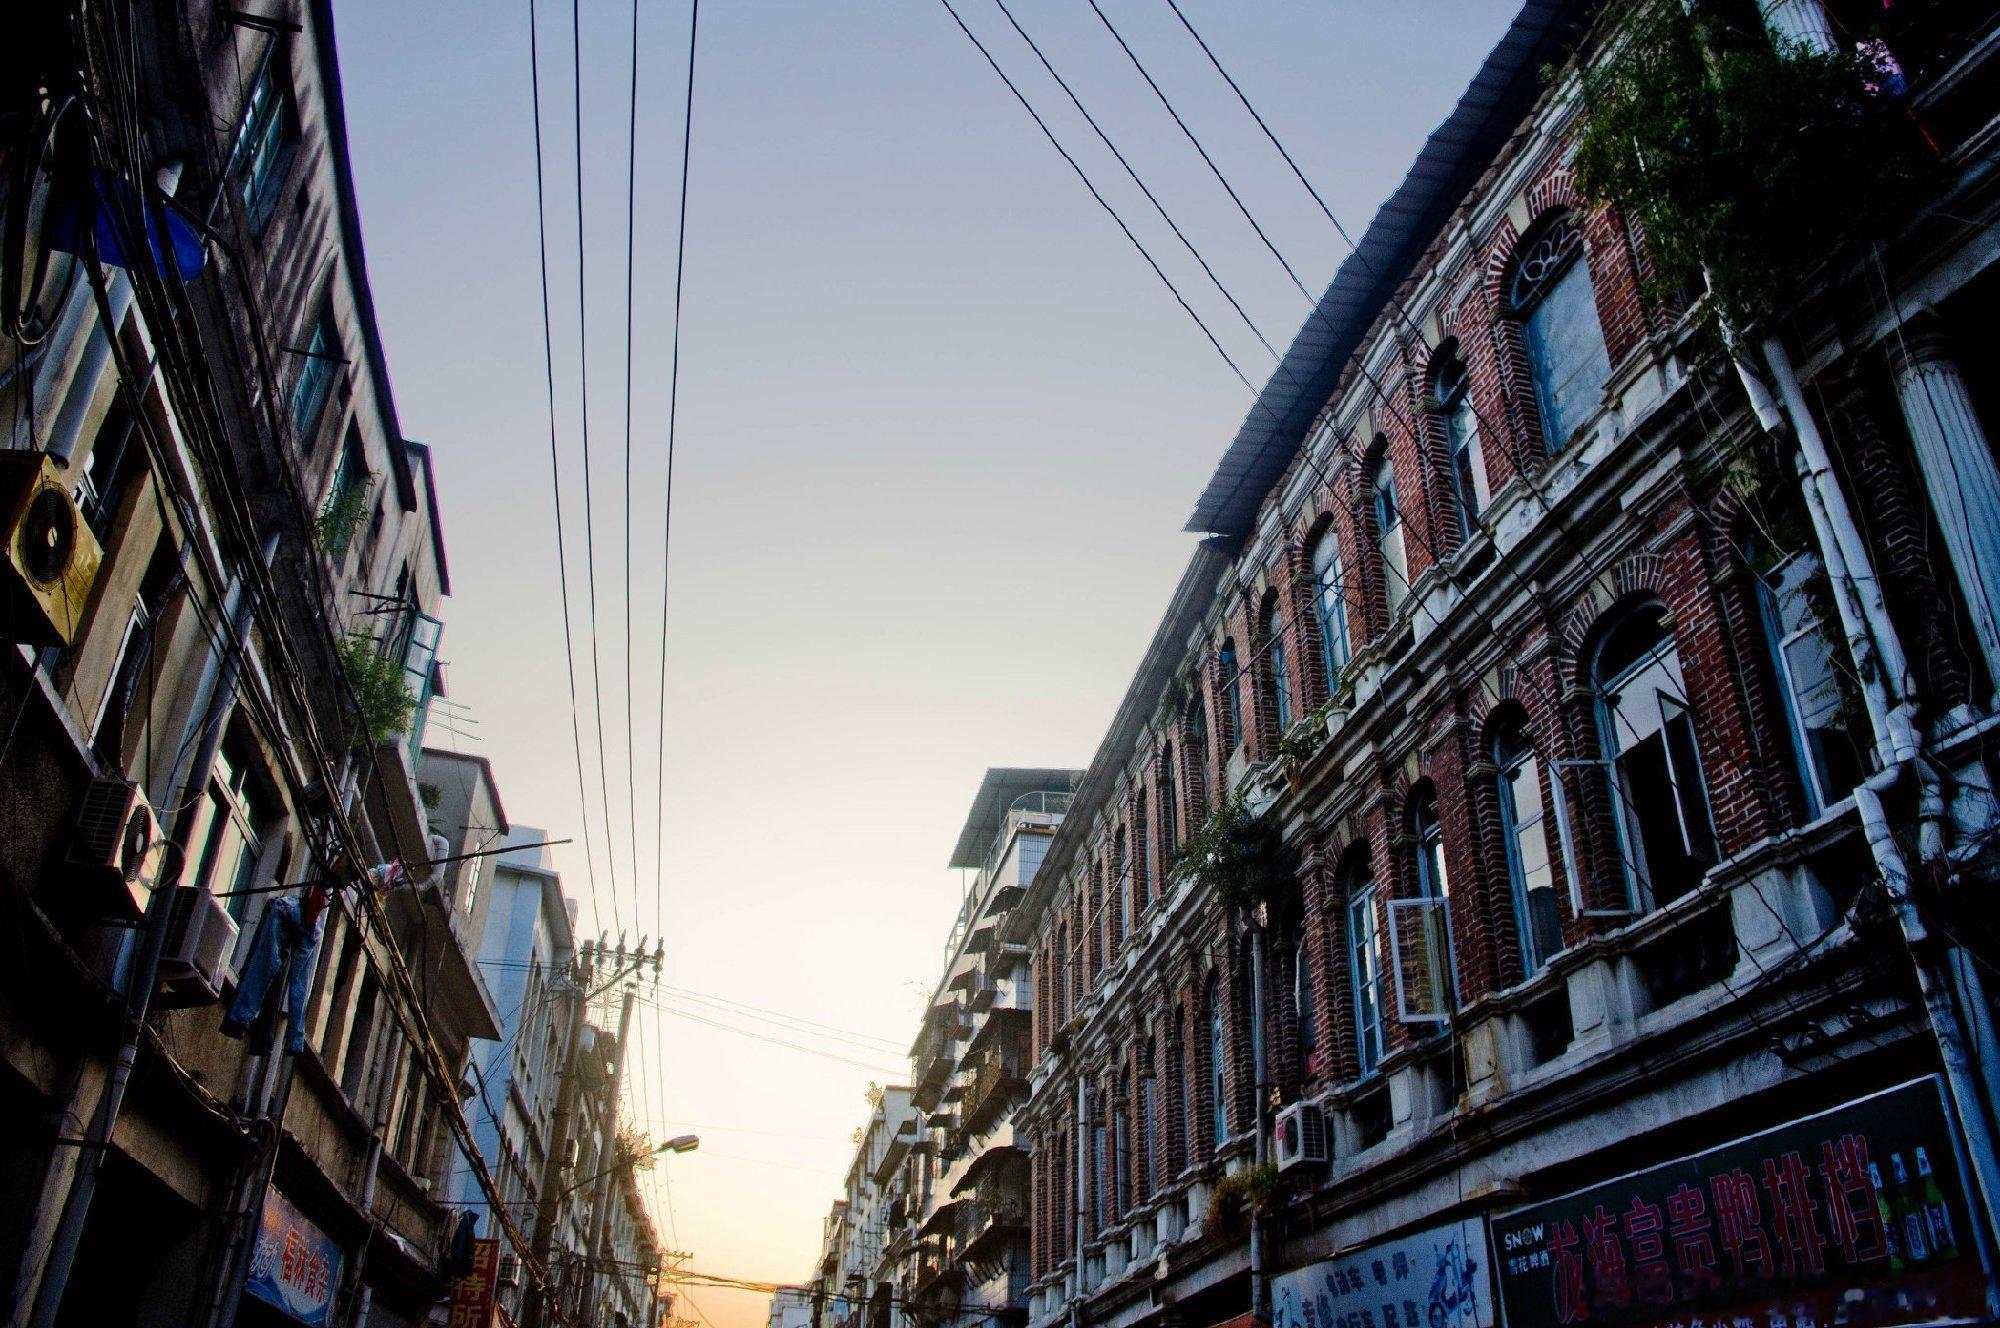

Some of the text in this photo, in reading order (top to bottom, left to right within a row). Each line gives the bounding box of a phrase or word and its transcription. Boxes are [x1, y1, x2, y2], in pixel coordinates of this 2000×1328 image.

[1503, 1222, 1545, 1252] SNOW
[1546, 1133, 1889, 1325] 龙海富贵鸭排档
[1506, 1249, 1551, 1276] 雪花啤酒
